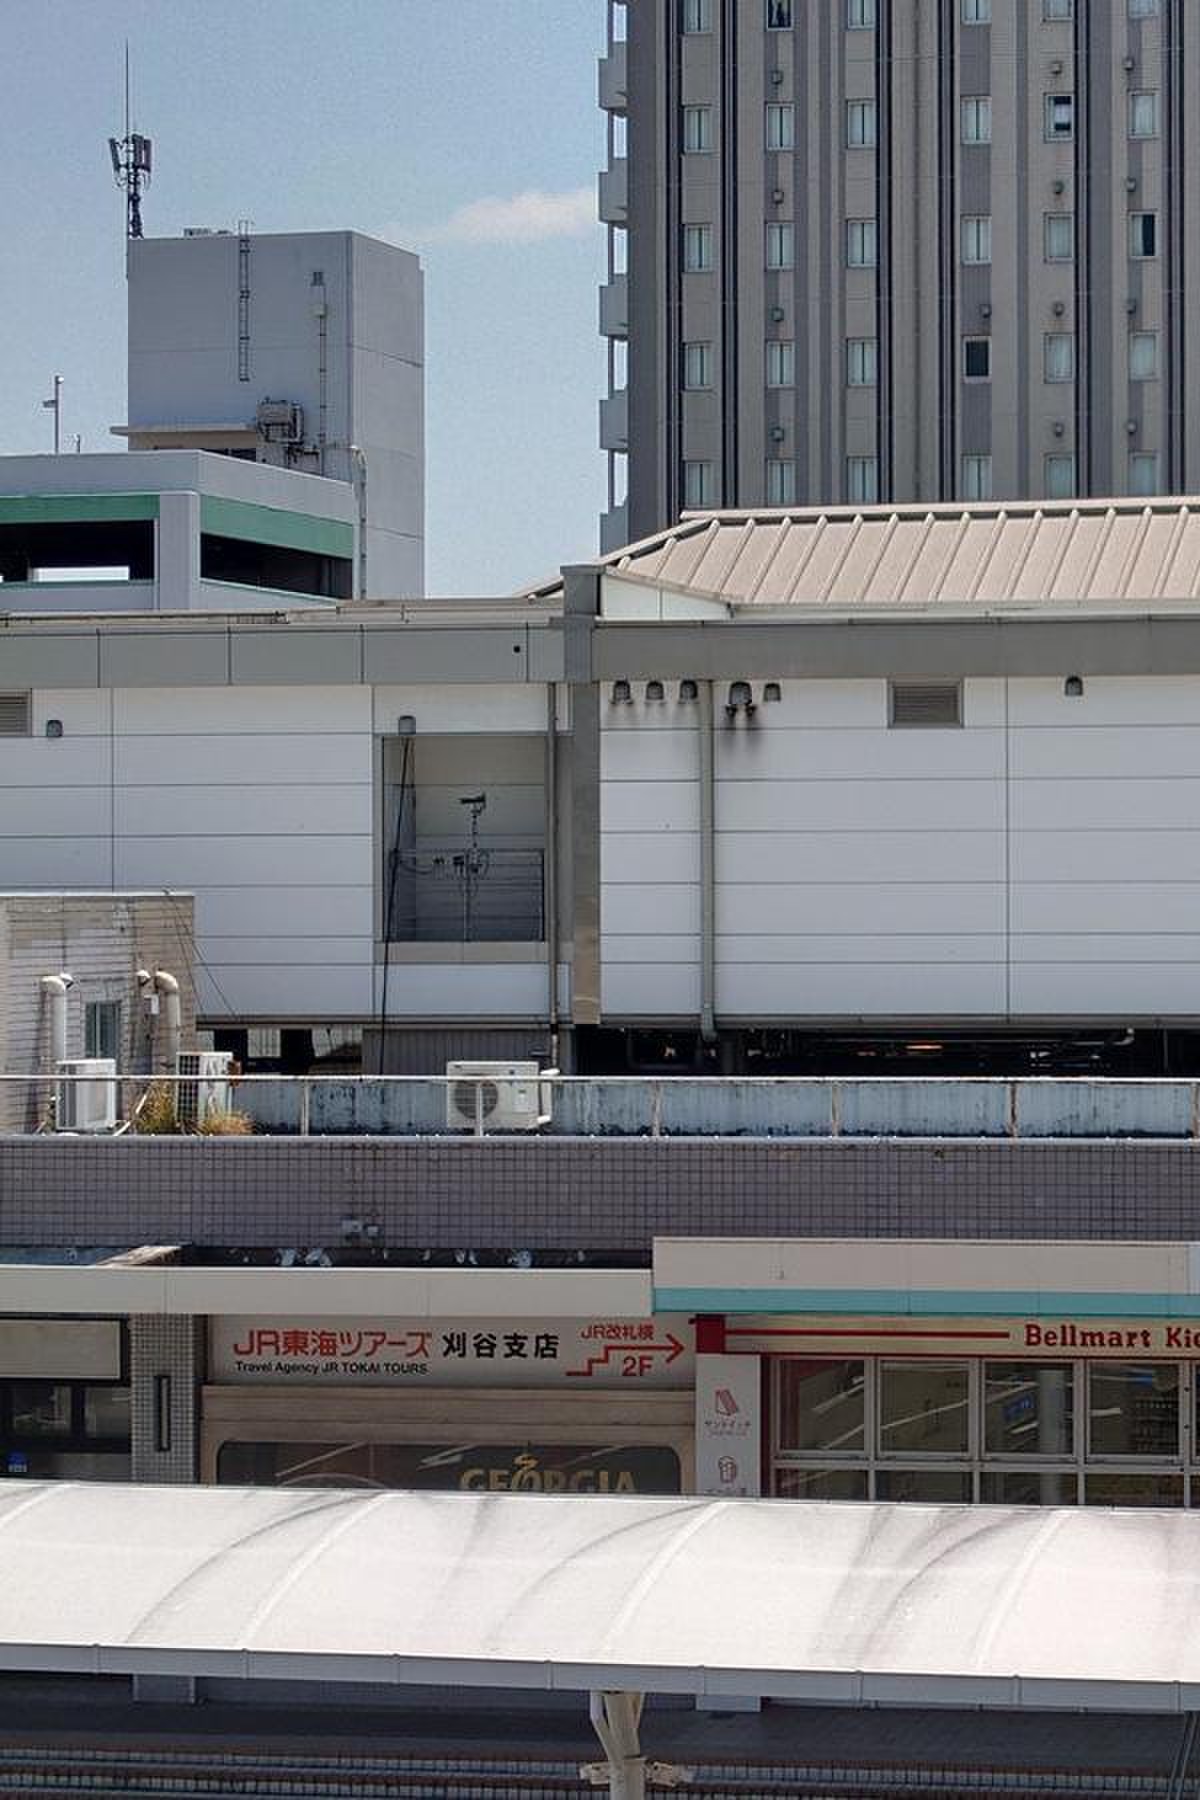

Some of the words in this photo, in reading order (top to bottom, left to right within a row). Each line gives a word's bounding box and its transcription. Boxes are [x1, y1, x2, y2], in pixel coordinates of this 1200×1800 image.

[233, 1328, 432, 1358] JR東海ツアーズ
[442, 1331, 561, 1360] 刈谷支店
[1024, 1323, 1151, 1348] Bellmart
[235, 1361, 272, 1373] Travel
[275, 1361, 319, 1376] Agency
[321, 1361, 338, 1373] JR
[340, 1362, 380, 1374] TOKAI
[383, 1363, 429, 1375] TOURS
[622, 1355, 655, 1377] 2F
